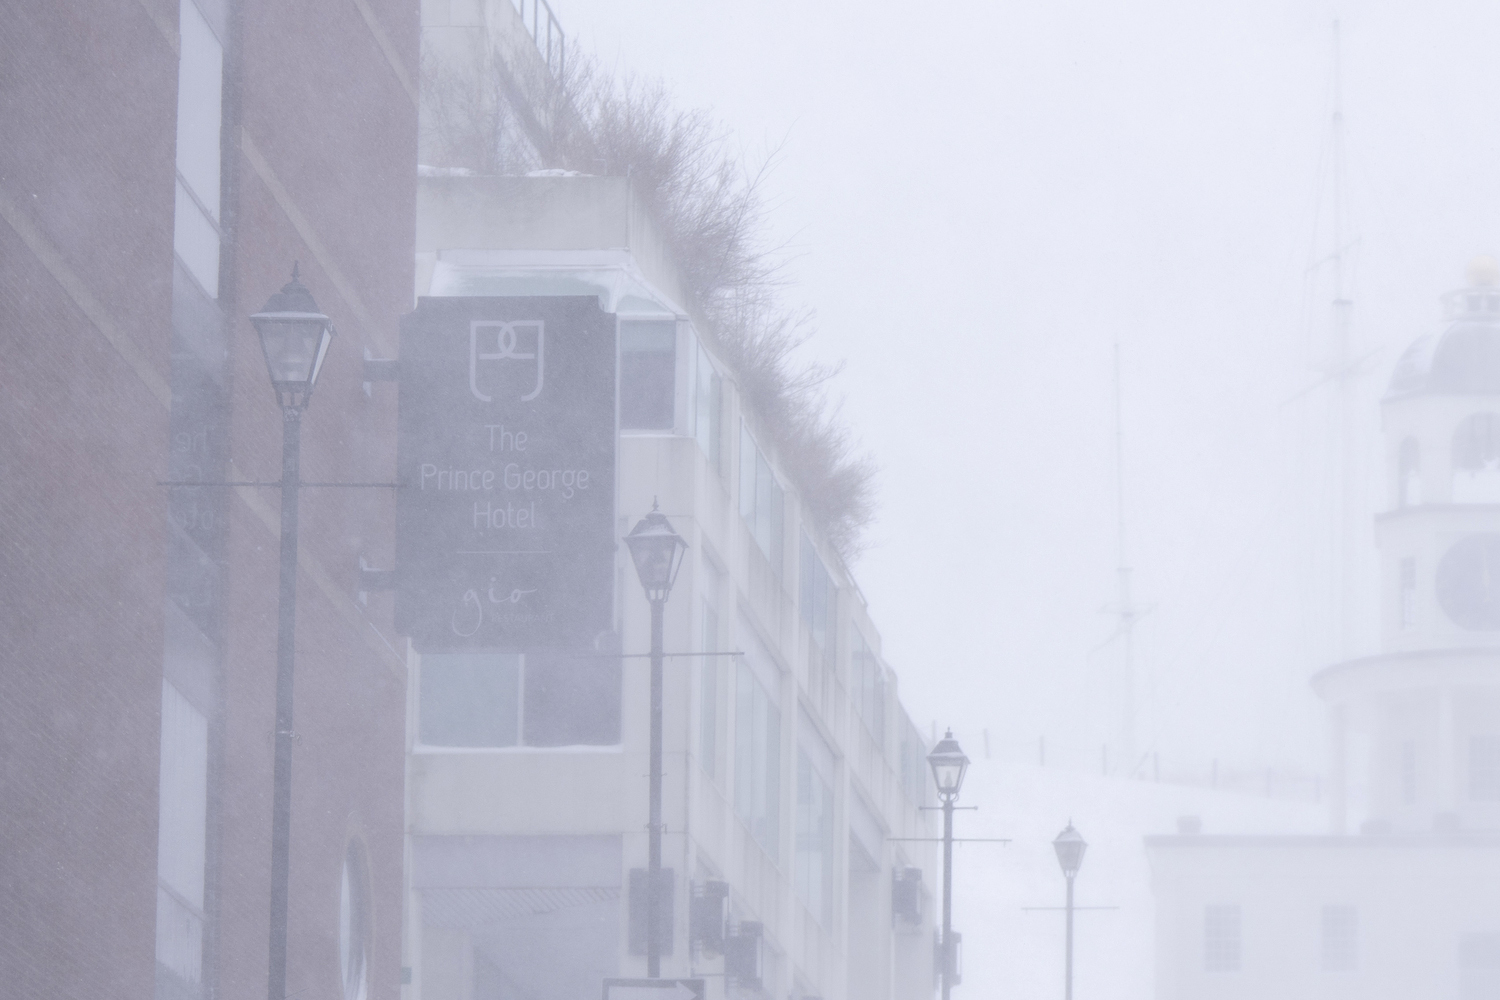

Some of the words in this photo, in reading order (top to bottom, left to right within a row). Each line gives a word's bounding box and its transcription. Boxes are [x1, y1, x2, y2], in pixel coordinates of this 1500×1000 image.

[484, 424, 528, 452] The
[420, 463, 495, 491] Prince
[503, 462, 590, 500] George
[473, 501, 536, 529] Hotel
[452, 576, 538, 637] gio
